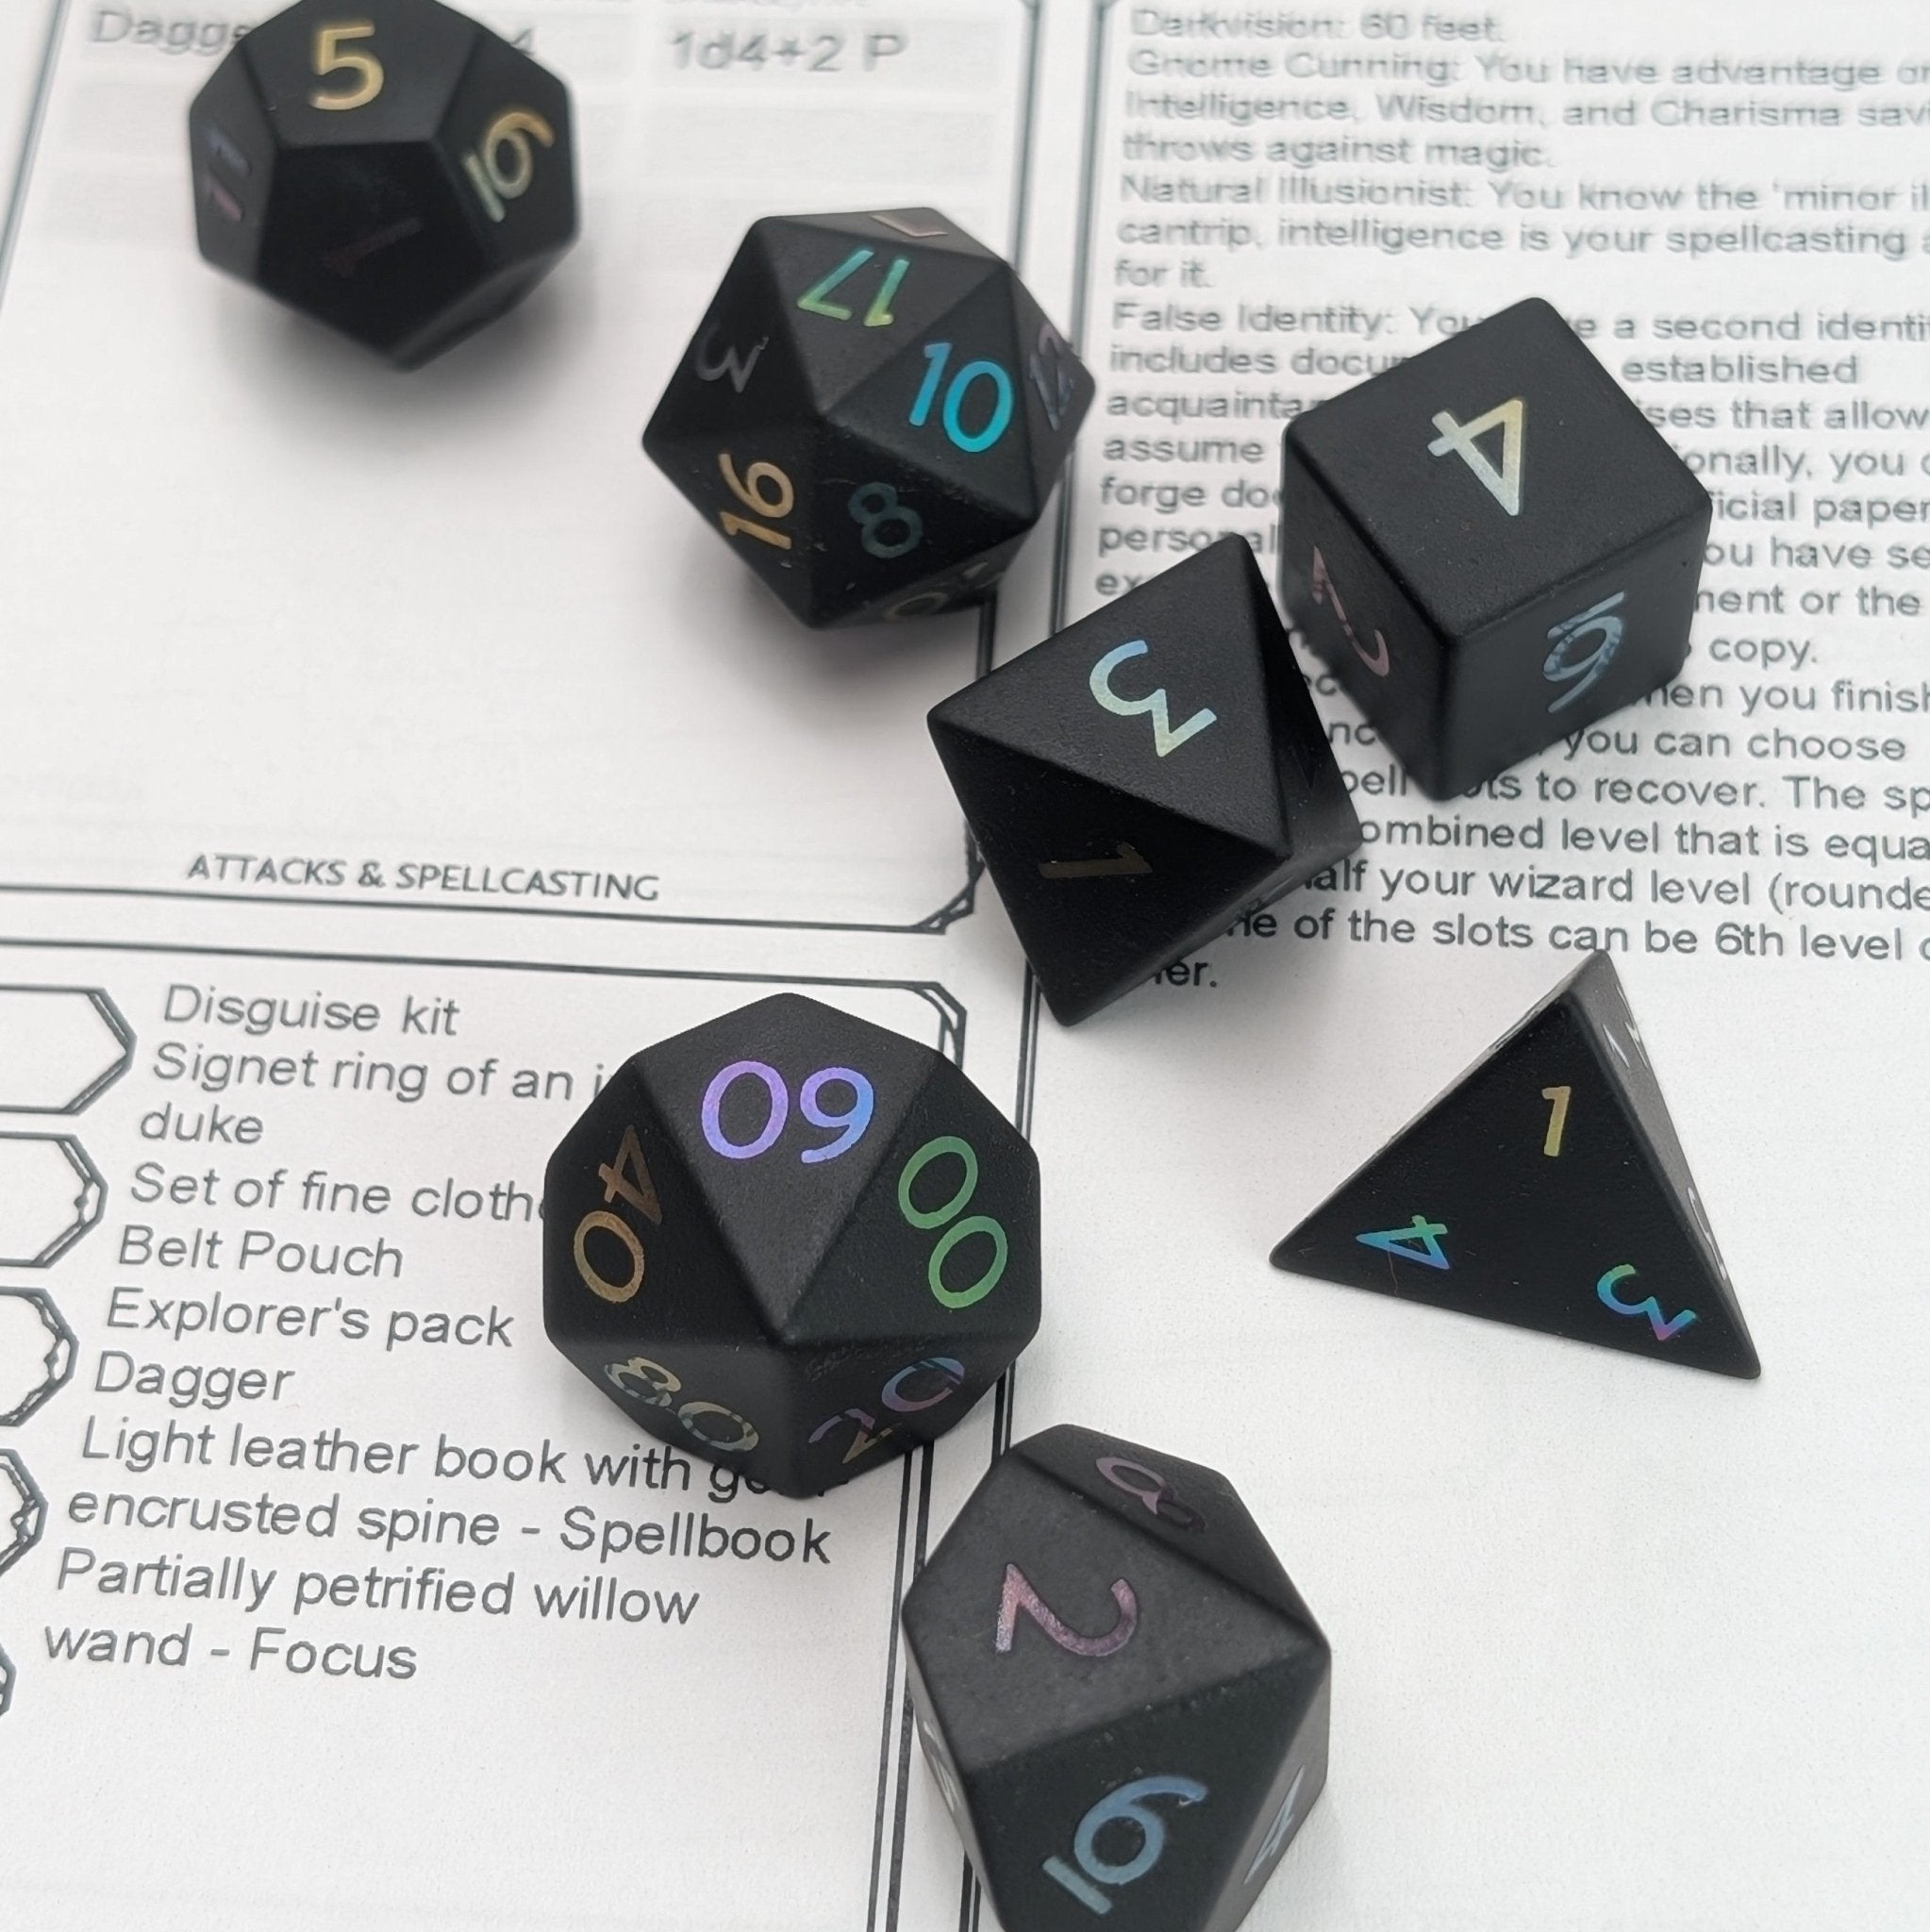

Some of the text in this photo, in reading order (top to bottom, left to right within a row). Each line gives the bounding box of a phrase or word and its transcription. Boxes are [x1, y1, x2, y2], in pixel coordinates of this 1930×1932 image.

[665, 26, 909, 73] 1d4+2 P
[1360, 11, 1411, 40] 60
[308, 19, 385, 111] 5
[1127, 48, 1274, 78] Gnome
[1474, 54, 1548, 85] You
[1563, 53, 1658, 85] have
[1672, 57, 1882, 92] advantage
[1562, 99, 1637, 127] and
[1650, 97, 1842, 127] Charisma
[1122, 131, 1557, 174] throws against magic.
[1120, 174, 1269, 205] Natural
[1488, 178, 1564, 209] You
[1578, 180, 1684, 210] know
[1695, 181, 1759, 210] the
[1277, 217, 1506, 255] intelligence
[1519, 221, 1552, 252] is
[1564, 228, 1653, 259] your
[1665, 223, 1906, 262] spellcasting
[797, 246, 911, 327] 17
[1114, 258, 1169, 289] for
[1111, 301, 1223, 332] False
[1237, 302, 1396, 341] Identity:
[1612, 317, 1637, 341] a
[1652, 312, 1802, 341] second
[695, 322, 770, 394] 3
[1109, 344, 1858, 384] includes docu established
[909, 341, 1014, 453] 10
[1729, 399, 1811, 429] that
[1102, 435, 1265, 463] assume
[1675, 443, 1812, 482] onally,
[1829, 449, 1905, 483] you
[1427, 396, 1523, 517] 4
[718, 452, 795, 551] 16
[849, 482, 923, 559] 8
[1099, 475, 1207, 512] forge
[1098, 523, 1280, 558] persoal
[1771, 536, 1872, 568] have
[1312, 544, 1390, 677] 2
[1799, 590, 1841, 615] or
[1855, 585, 1922, 616] the
[1708, 637, 1819, 671] copy.
[1089, 640, 1218, 758] 3
[1739, 684, 1817, 717] you
[1563, 727, 1907, 761] you can choose
[1535, 770, 1577, 802] to
[1593, 775, 1766, 808] recover.
[1781, 775, 1867, 811] The
[1360, 813, 1544, 849] ombined
[1560, 817, 1660, 854] level
[1673, 823, 1761, 857] that
[1773, 824, 1810, 858] is
[187, 854, 661, 902] ATTACKS & SPELLCASTING
[1305, 858, 1369, 892] alf
[1378, 866, 1476, 902] your
[1489, 864, 1634, 904] wizard
[1650, 869, 1751, 906] level
[1293, 907, 1337, 941] of
[1347, 908, 1417, 943] the
[1431, 912, 1535, 949] slots
[1547, 922, 1629, 953] can
[1644, 920, 1699, 955] be
[1714, 921, 1785, 958] 6th
[1799, 924, 1903, 961] level
[163, 983, 461, 1037] Disguise kit
[152, 1041, 319, 1092] Signet
[332, 1051, 429, 1103] ring
[446, 1058, 501, 1097] of
[511, 1067, 574, 1102] an
[140, 1101, 265, 1145] duke
[1541, 1085, 1572, 1158] 1
[130, 1160, 544, 1223] Set of fine cloth
[574, 1124, 663, 1304] 40
[897, 1136, 1008, 1308] 00
[1356, 1214, 1450, 1270] 4
[118, 1224, 404, 1279] Belt Pouch
[107, 1285, 516, 1352] Explorer's pack
[1596, 1262, 1697, 1341] 3
[94, 1350, 296, 1410] Dagger
[604, 1356, 759, 1453] 80
[808, 1357, 965, 1464] 20
[81, 1414, 216, 1473] Light
[229, 1422, 421, 1476] leather
[433, 1433, 567, 1485] book
[584, 1442, 691, 1491] with
[67, 1491, 341, 1539] encrusted
[356, 1497, 501, 1553] spine
[558, 1504, 832, 1565] Spellbook
[57, 1545, 701, 1625] Partially petrified willow
[995, 1562, 1139, 1657] 2
[43, 1622, 193, 1667] wand
[249, 1624, 418, 1680] Focus
[1041, 1774, 1208, 1916] 6
